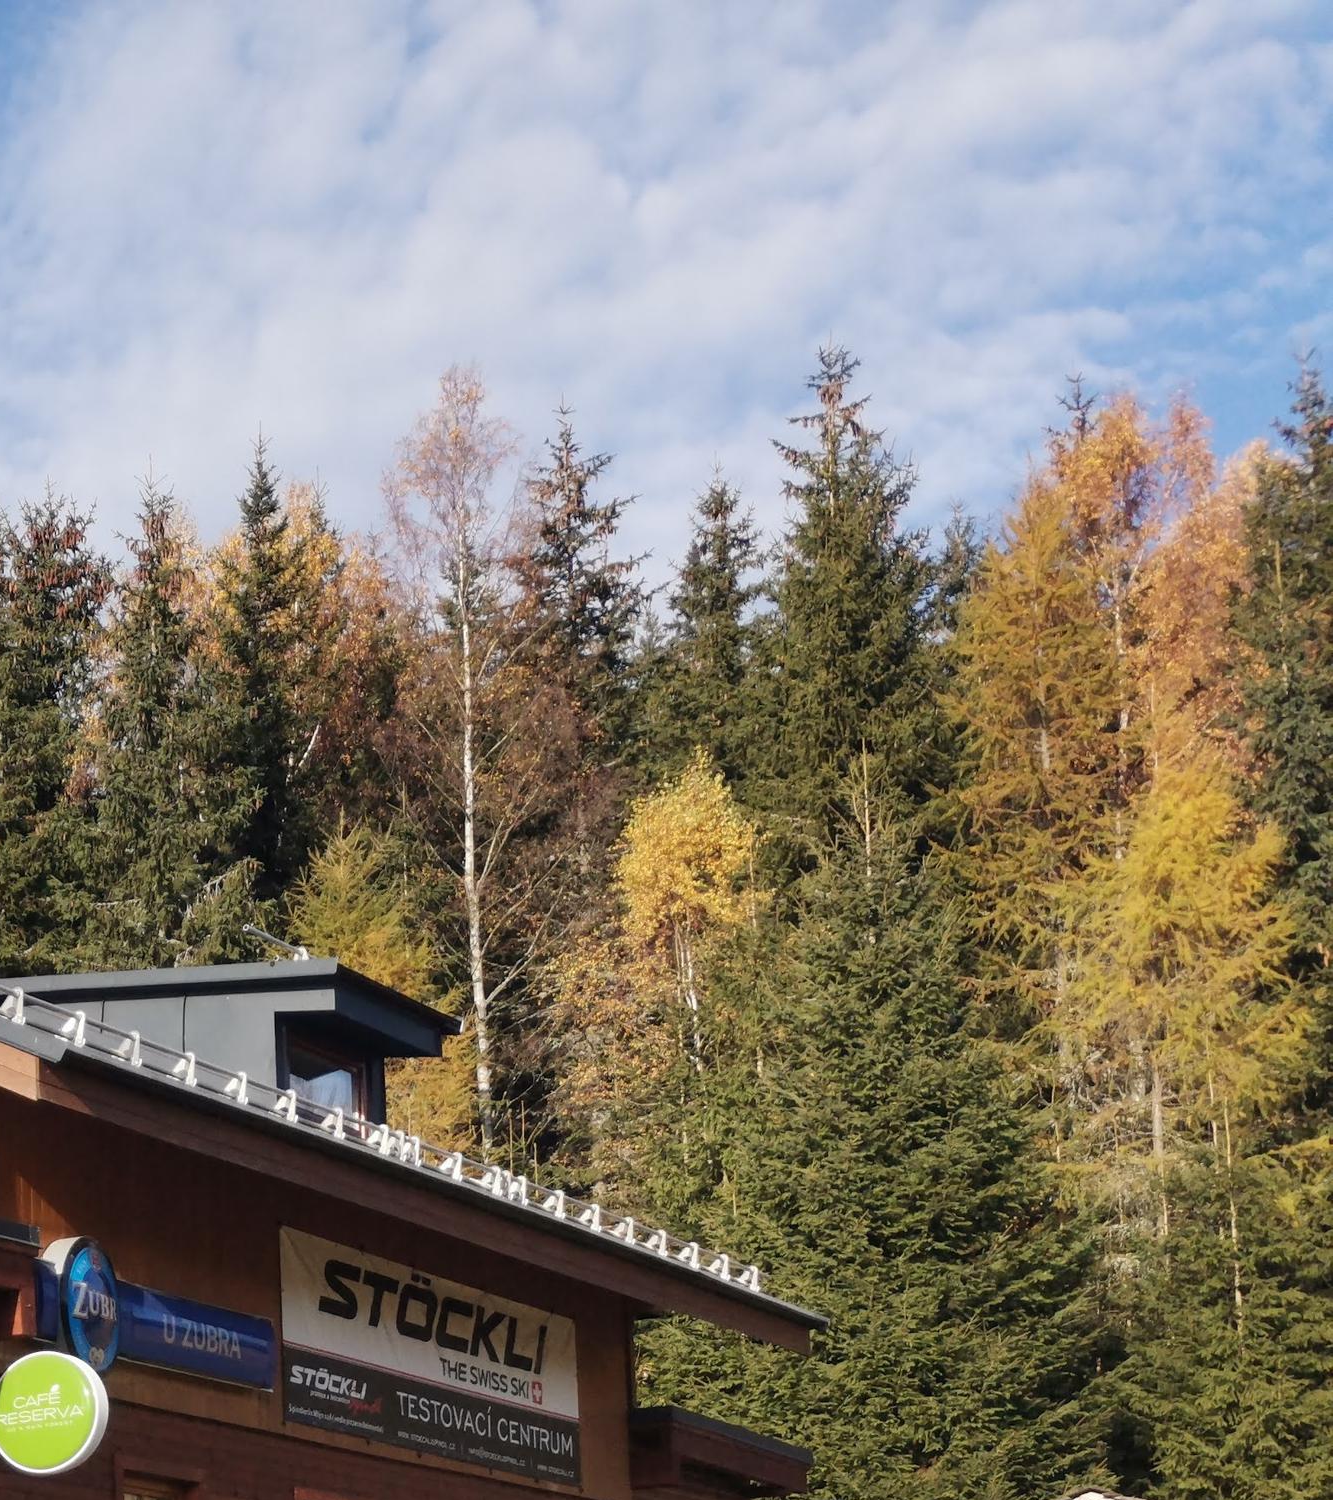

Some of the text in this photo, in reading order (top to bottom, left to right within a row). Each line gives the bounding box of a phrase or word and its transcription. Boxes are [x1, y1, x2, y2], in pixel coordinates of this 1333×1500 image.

[163, 1313, 241, 1360] U ZUBRA
[318, 1259, 547, 1375] STÖCKLI
[290, 1365, 368, 1400] STÖCKLI
[439, 1357, 530, 1399] THE SWISS SKI
[396, 1391, 493, 1438] TESTOVACÍ
[497, 1417, 574, 1458] CENTRUM
